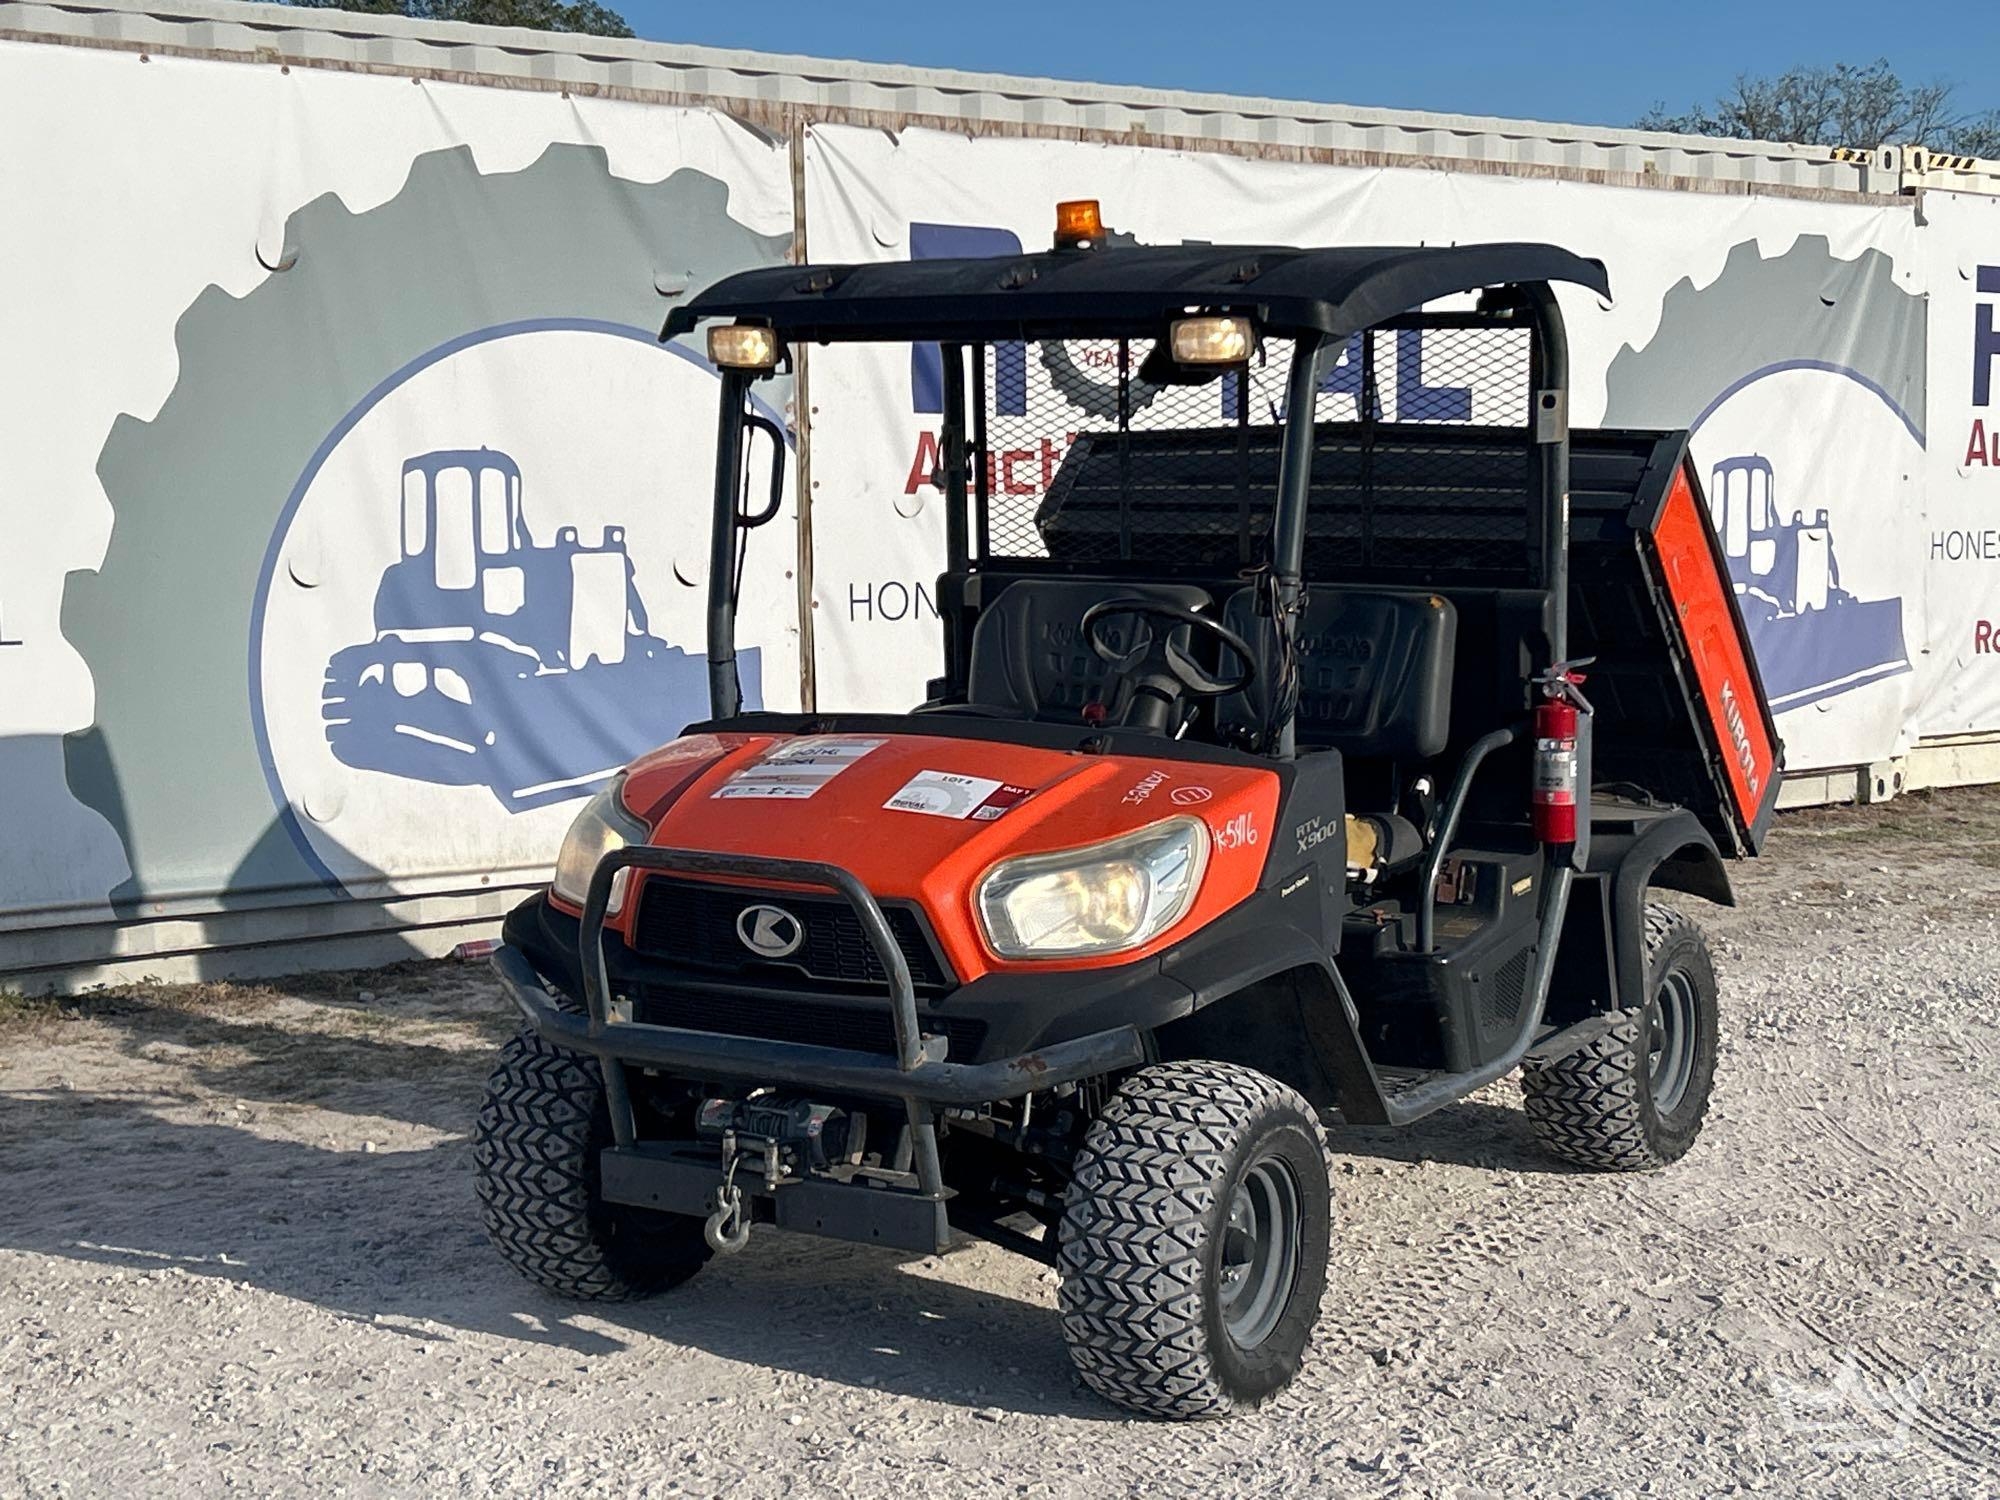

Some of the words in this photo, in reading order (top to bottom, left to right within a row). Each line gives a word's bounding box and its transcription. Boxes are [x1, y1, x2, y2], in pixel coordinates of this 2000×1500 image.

[1082, 349, 1135, 368] YEAS
[1930, 530, 2000, 561] HONE
[1003, 785, 1024, 794] DAY
[890, 799, 926, 809] ROYAL
[1295, 815, 1321, 839] RTV
[1296, 820, 1337, 855] X900
